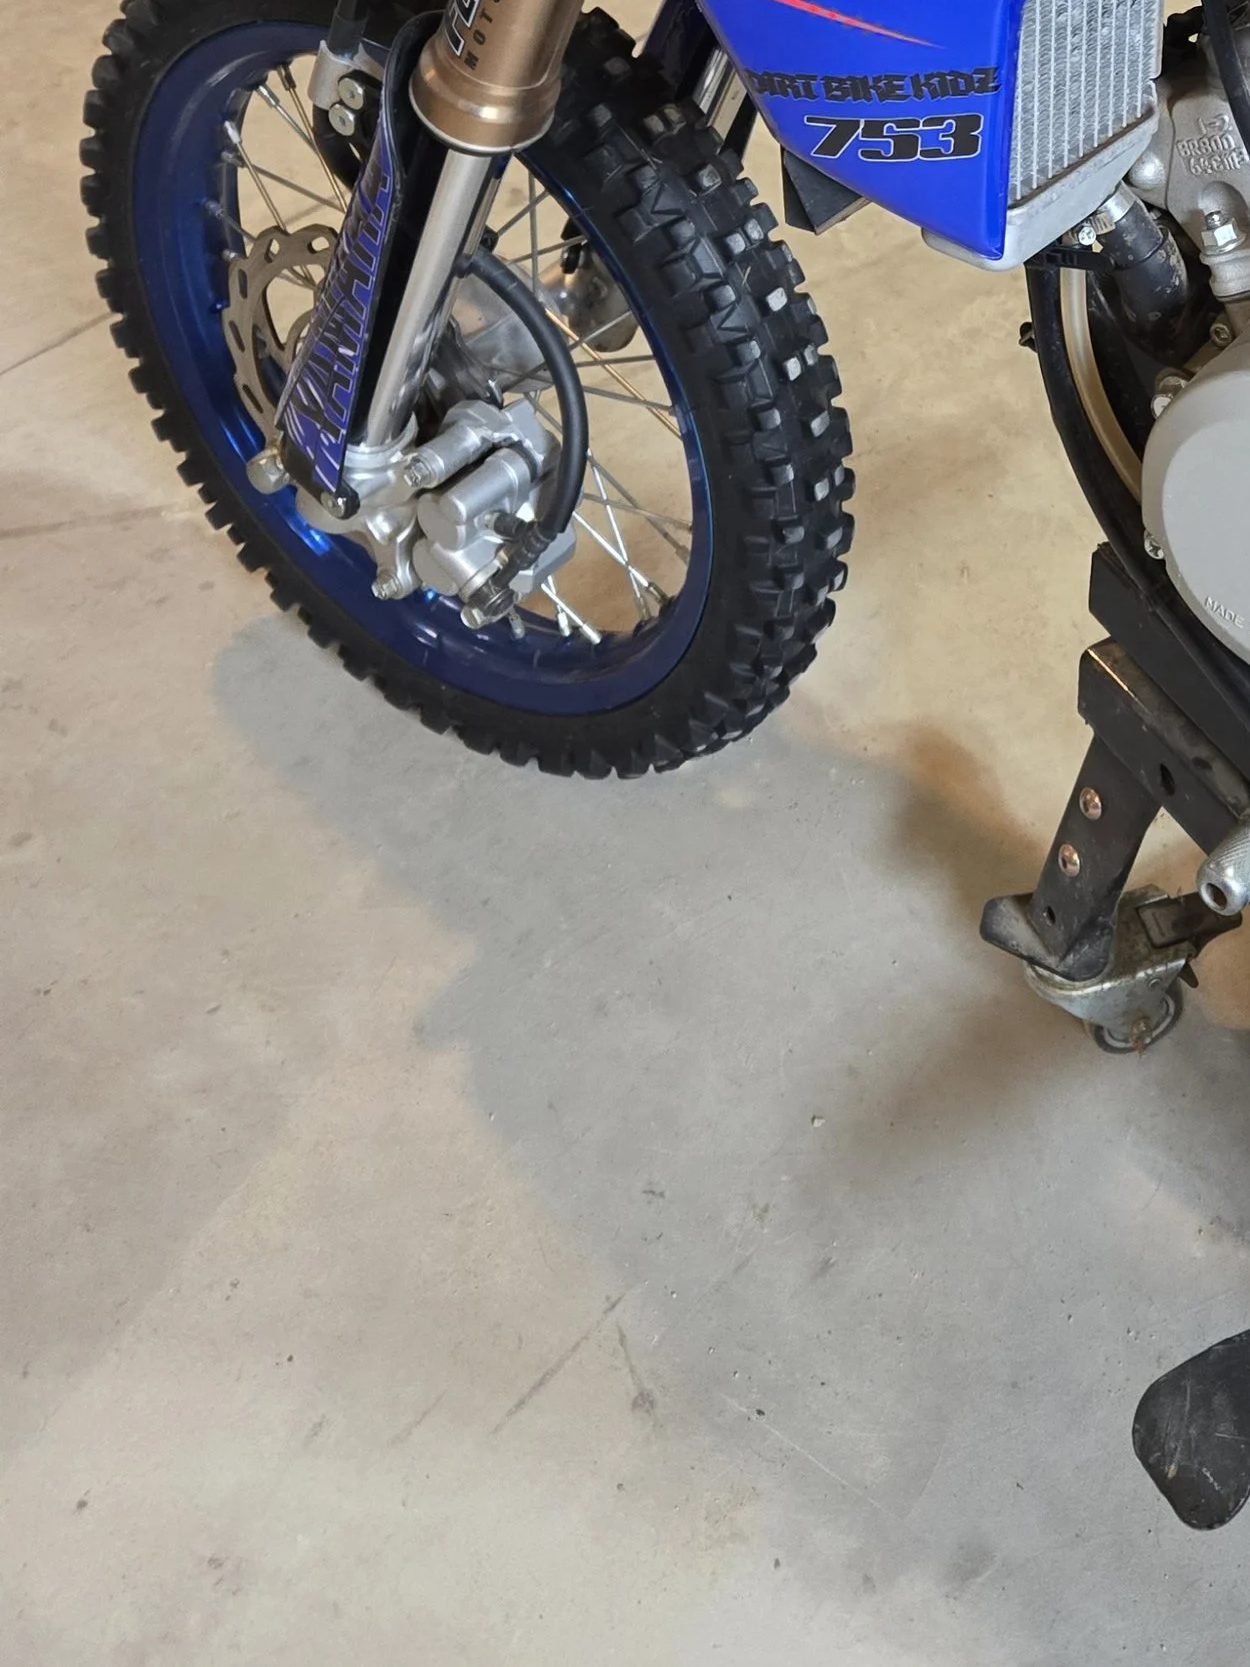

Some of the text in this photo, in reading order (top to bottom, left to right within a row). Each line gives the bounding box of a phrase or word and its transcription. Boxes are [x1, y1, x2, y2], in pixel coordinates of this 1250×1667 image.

[747, 65, 1000, 104] DIRT BIKE KIDZ
[804, 112, 985, 162] 753
[1204, 595, 1245, 628] MADE
